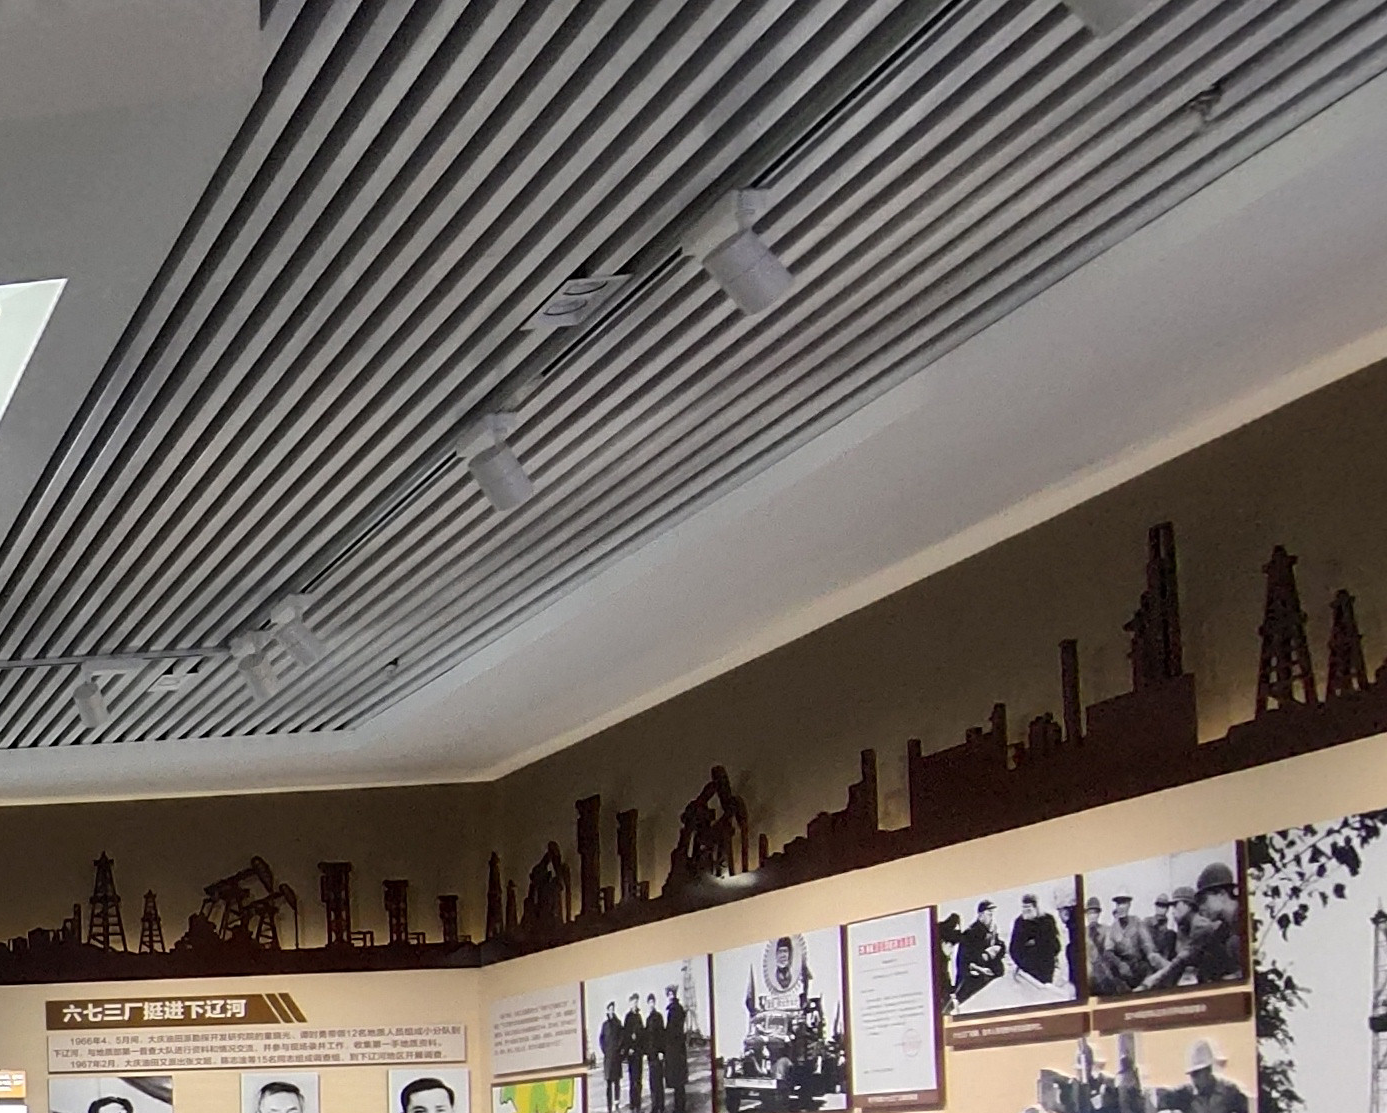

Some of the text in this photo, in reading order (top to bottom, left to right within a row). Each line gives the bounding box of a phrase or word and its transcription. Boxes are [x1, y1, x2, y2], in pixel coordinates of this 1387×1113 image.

[62, 998, 247, 1023] 六七三厂挺进下辽河
